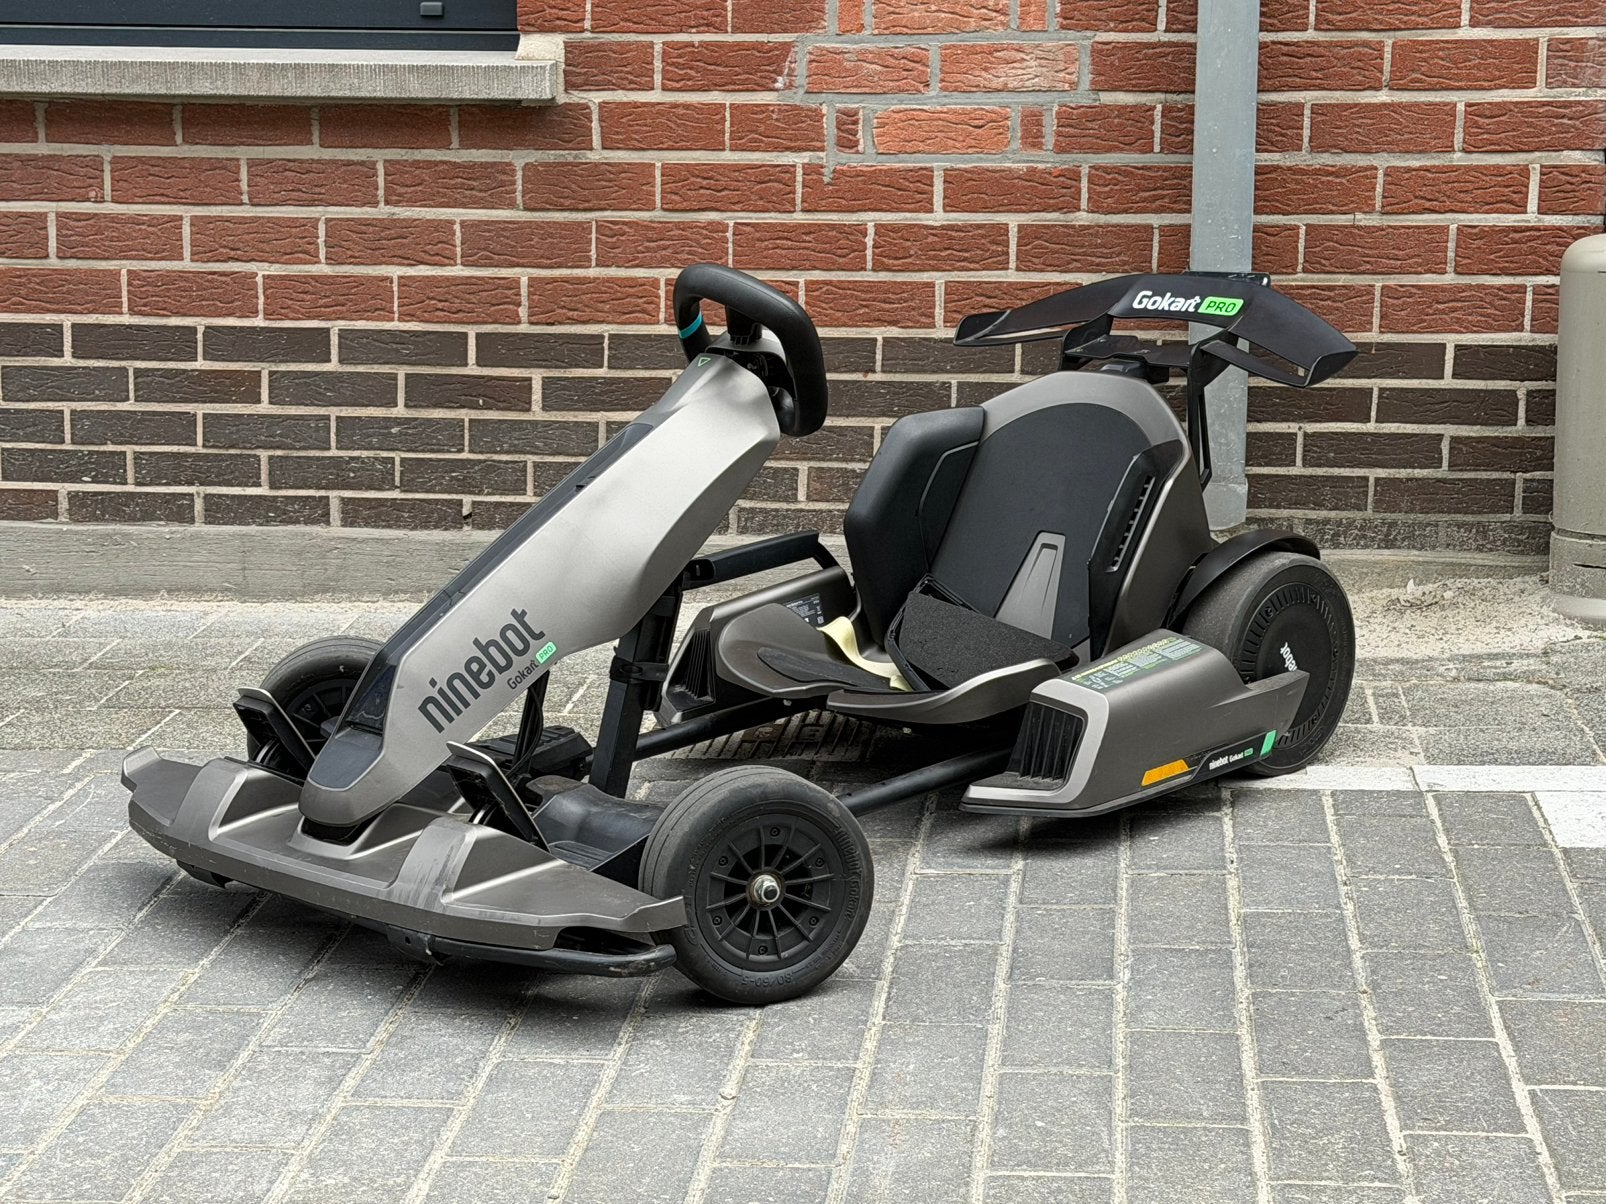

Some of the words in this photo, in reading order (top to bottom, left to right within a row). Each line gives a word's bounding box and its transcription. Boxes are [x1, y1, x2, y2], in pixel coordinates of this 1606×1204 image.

[1132, 290, 1201, 313] Gokart
[1204, 299, 1237, 314] PRO
[417, 608, 546, 734] ninebot
[506, 659, 540, 690] Gokart
[538, 643, 554, 660] PRO
